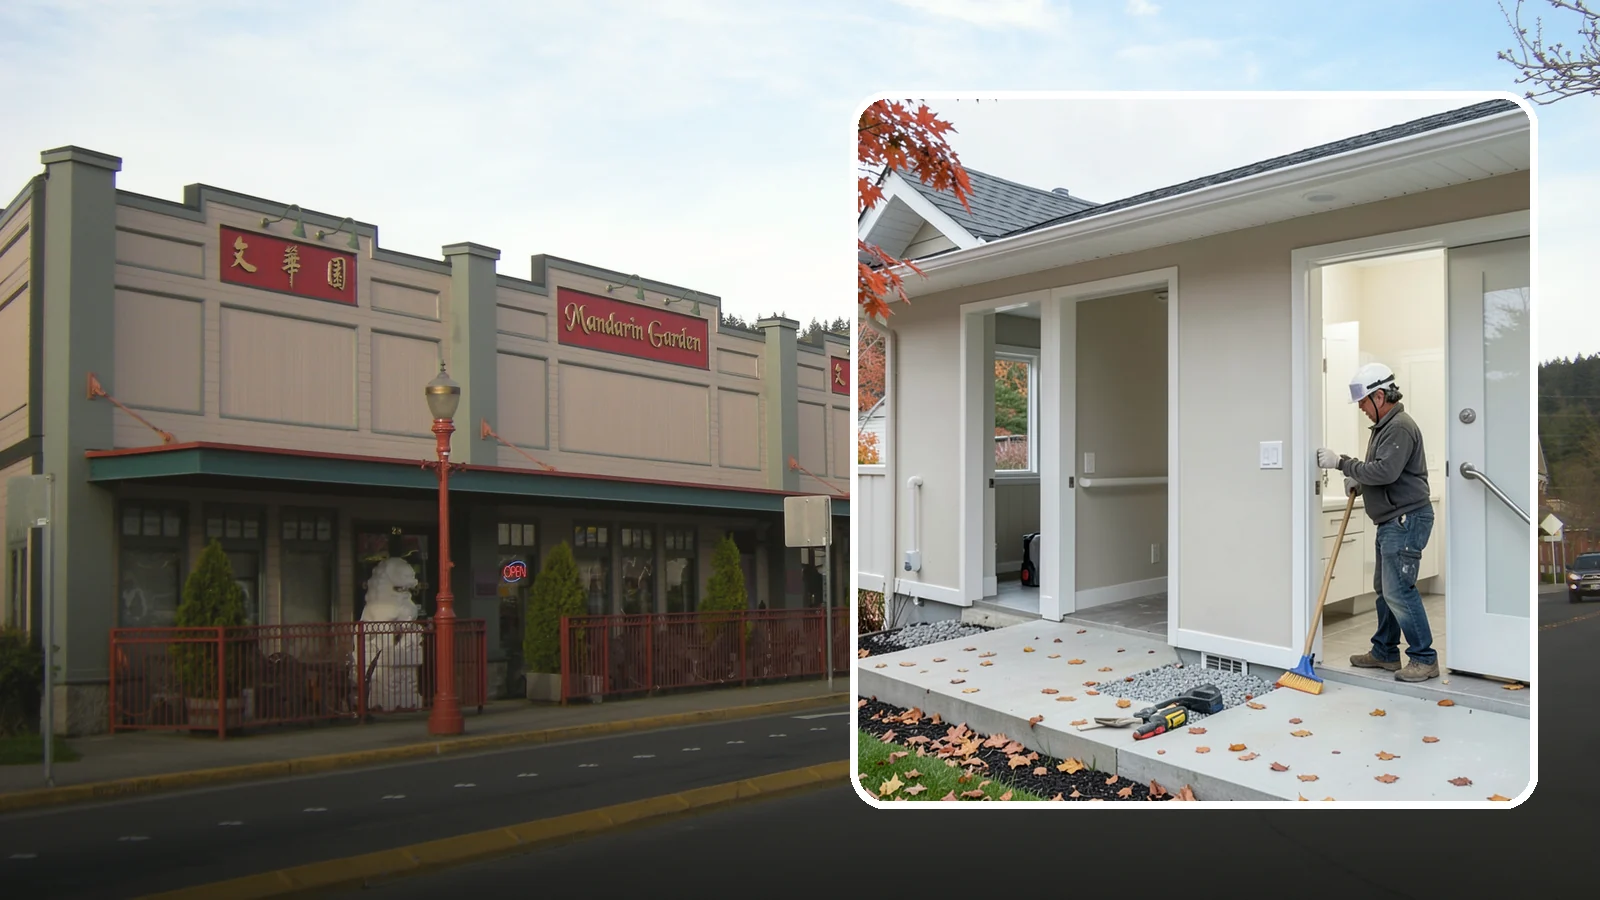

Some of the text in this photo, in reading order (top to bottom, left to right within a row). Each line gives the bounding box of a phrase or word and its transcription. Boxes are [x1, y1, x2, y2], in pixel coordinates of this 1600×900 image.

[565, 302, 702, 352] Mandarin Garden
[503, 565, 527, 578] OPEN
